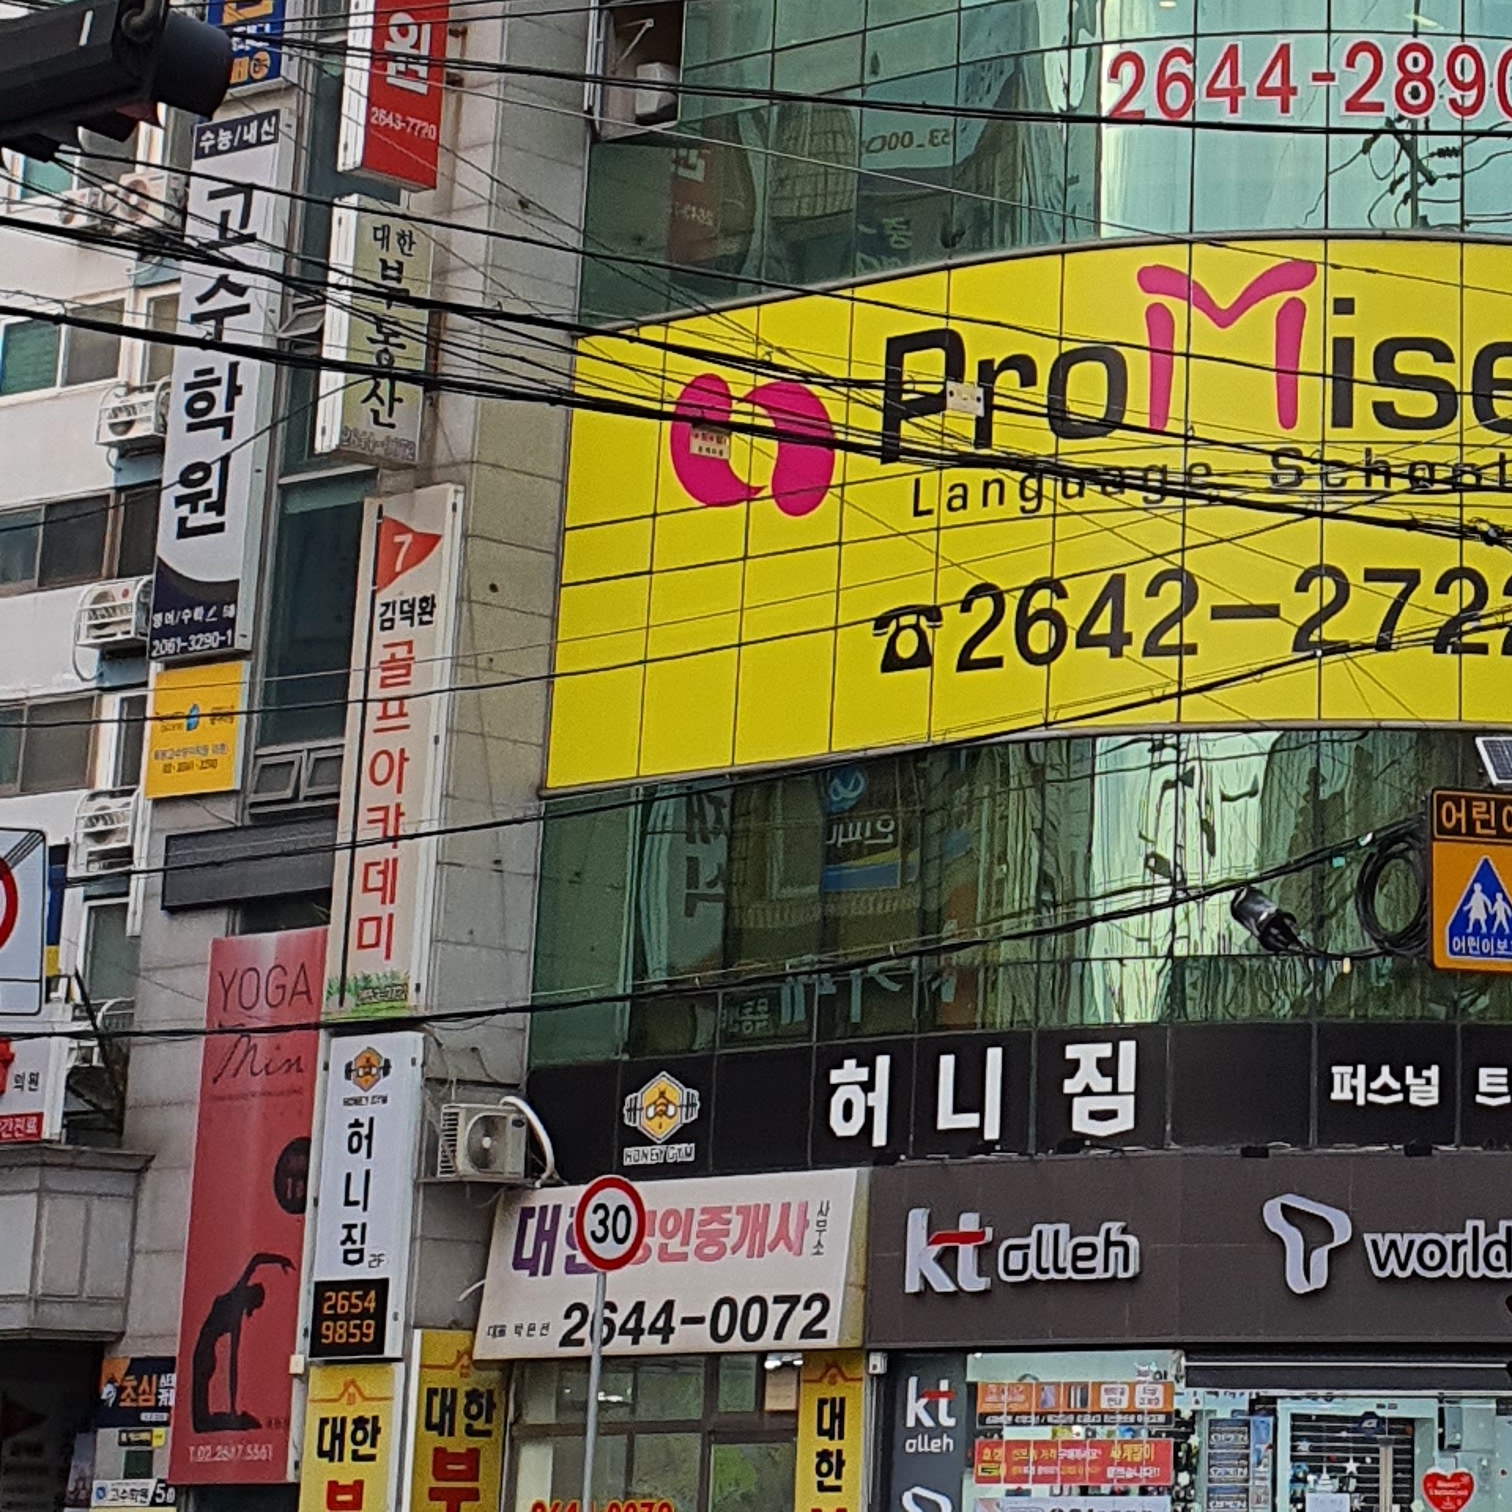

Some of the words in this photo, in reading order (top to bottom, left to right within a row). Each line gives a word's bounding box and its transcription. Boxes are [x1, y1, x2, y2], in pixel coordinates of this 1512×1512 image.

[373, 223, 417, 257] 대한
[393, 533, 412, 572] 7
[378, 593, 436, 632] 김덕환
[218, 962, 313, 1012] YOGA
[829, 1040, 1137, 1148] 허니짐
[1330, 1064, 1440, 1107] 퍼스널
[0, 1116, 38, 1139] 간진료
[340, 1116, 375, 1267] 허니짐
[590, 1202, 632, 1246] 30
[905, 1206, 994, 1294] kt
[1000, 1222, 1140, 1282] olleh
[322, 1291, 377, 1315] 2654
[558, 1291, 831, 1349] 2644-0072
[320, 1319, 376, 1345] 9859
[424, 1385, 496, 1440] 대한
[905, 1375, 957, 1429] kt
[316, 1414, 382, 1465] 대한
[815, 1395, 846, 1494] 대한
[904, 1436, 955, 1456] olleh
